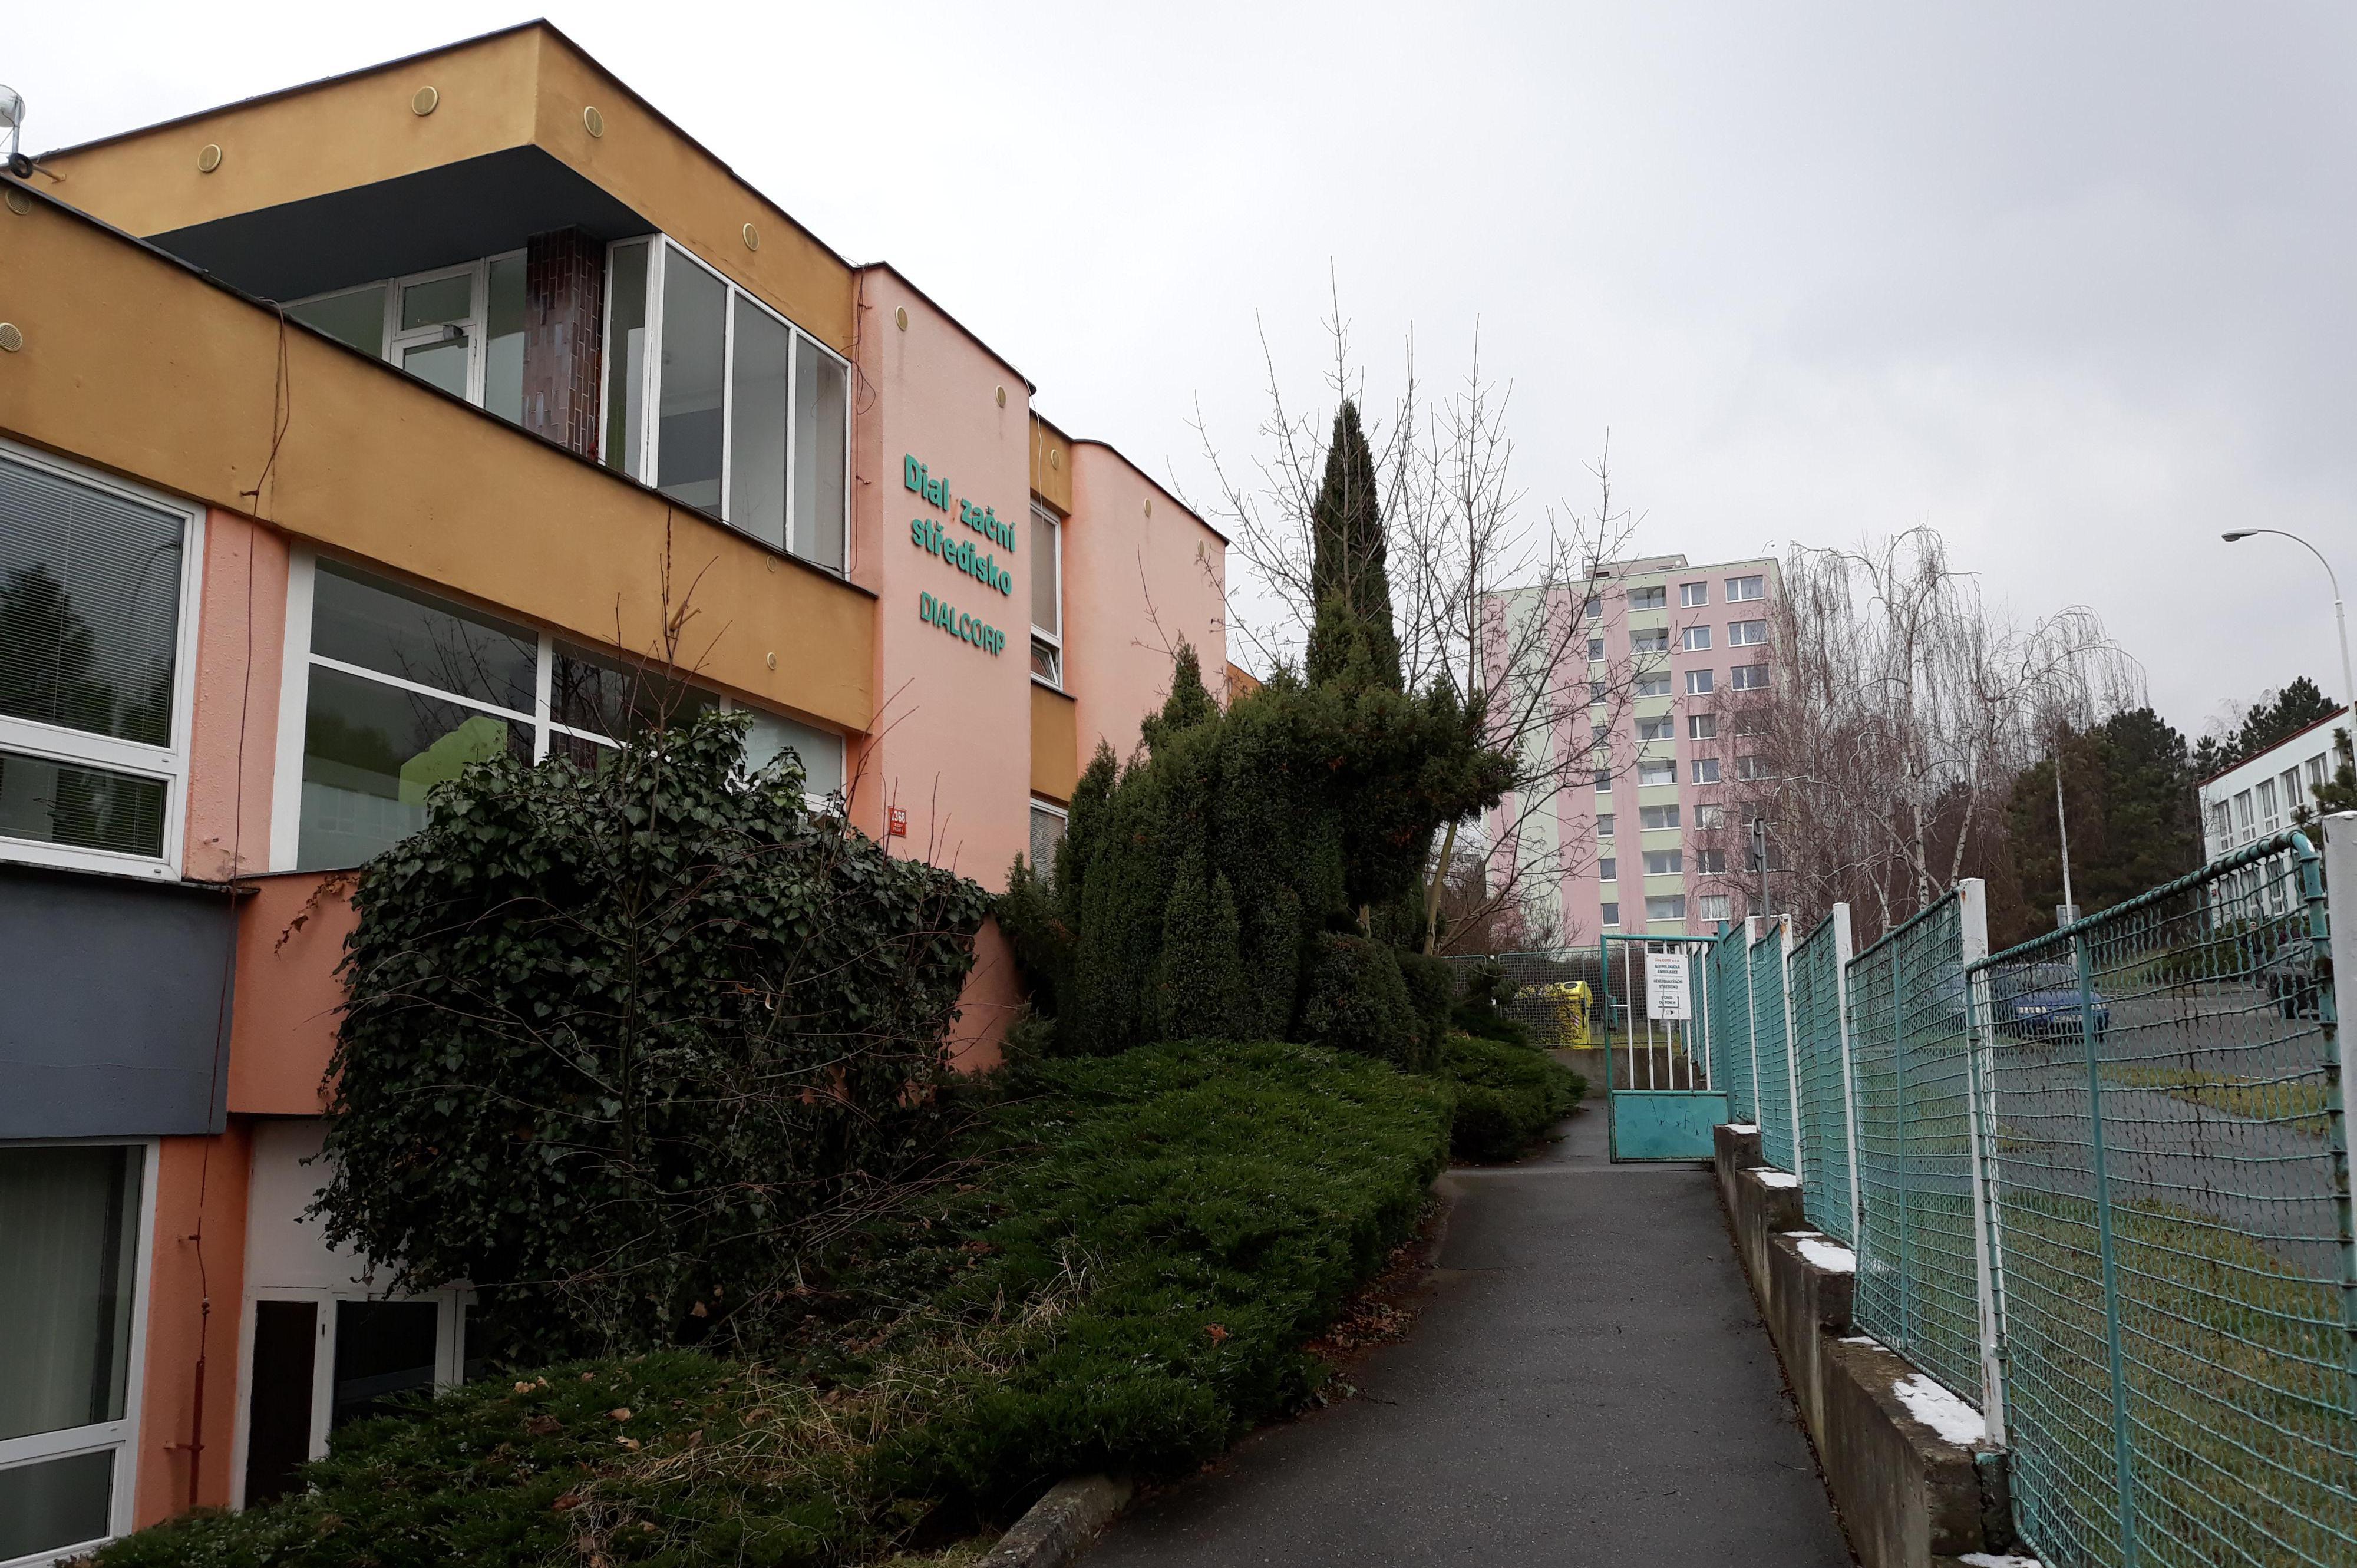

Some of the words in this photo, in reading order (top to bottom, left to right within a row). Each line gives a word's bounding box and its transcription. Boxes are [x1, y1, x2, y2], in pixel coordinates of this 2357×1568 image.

[911, 518, 1012, 596] středisko
[920, 591, 1005, 655] DIALCORP
[891, 810, 906, 824] 1368
